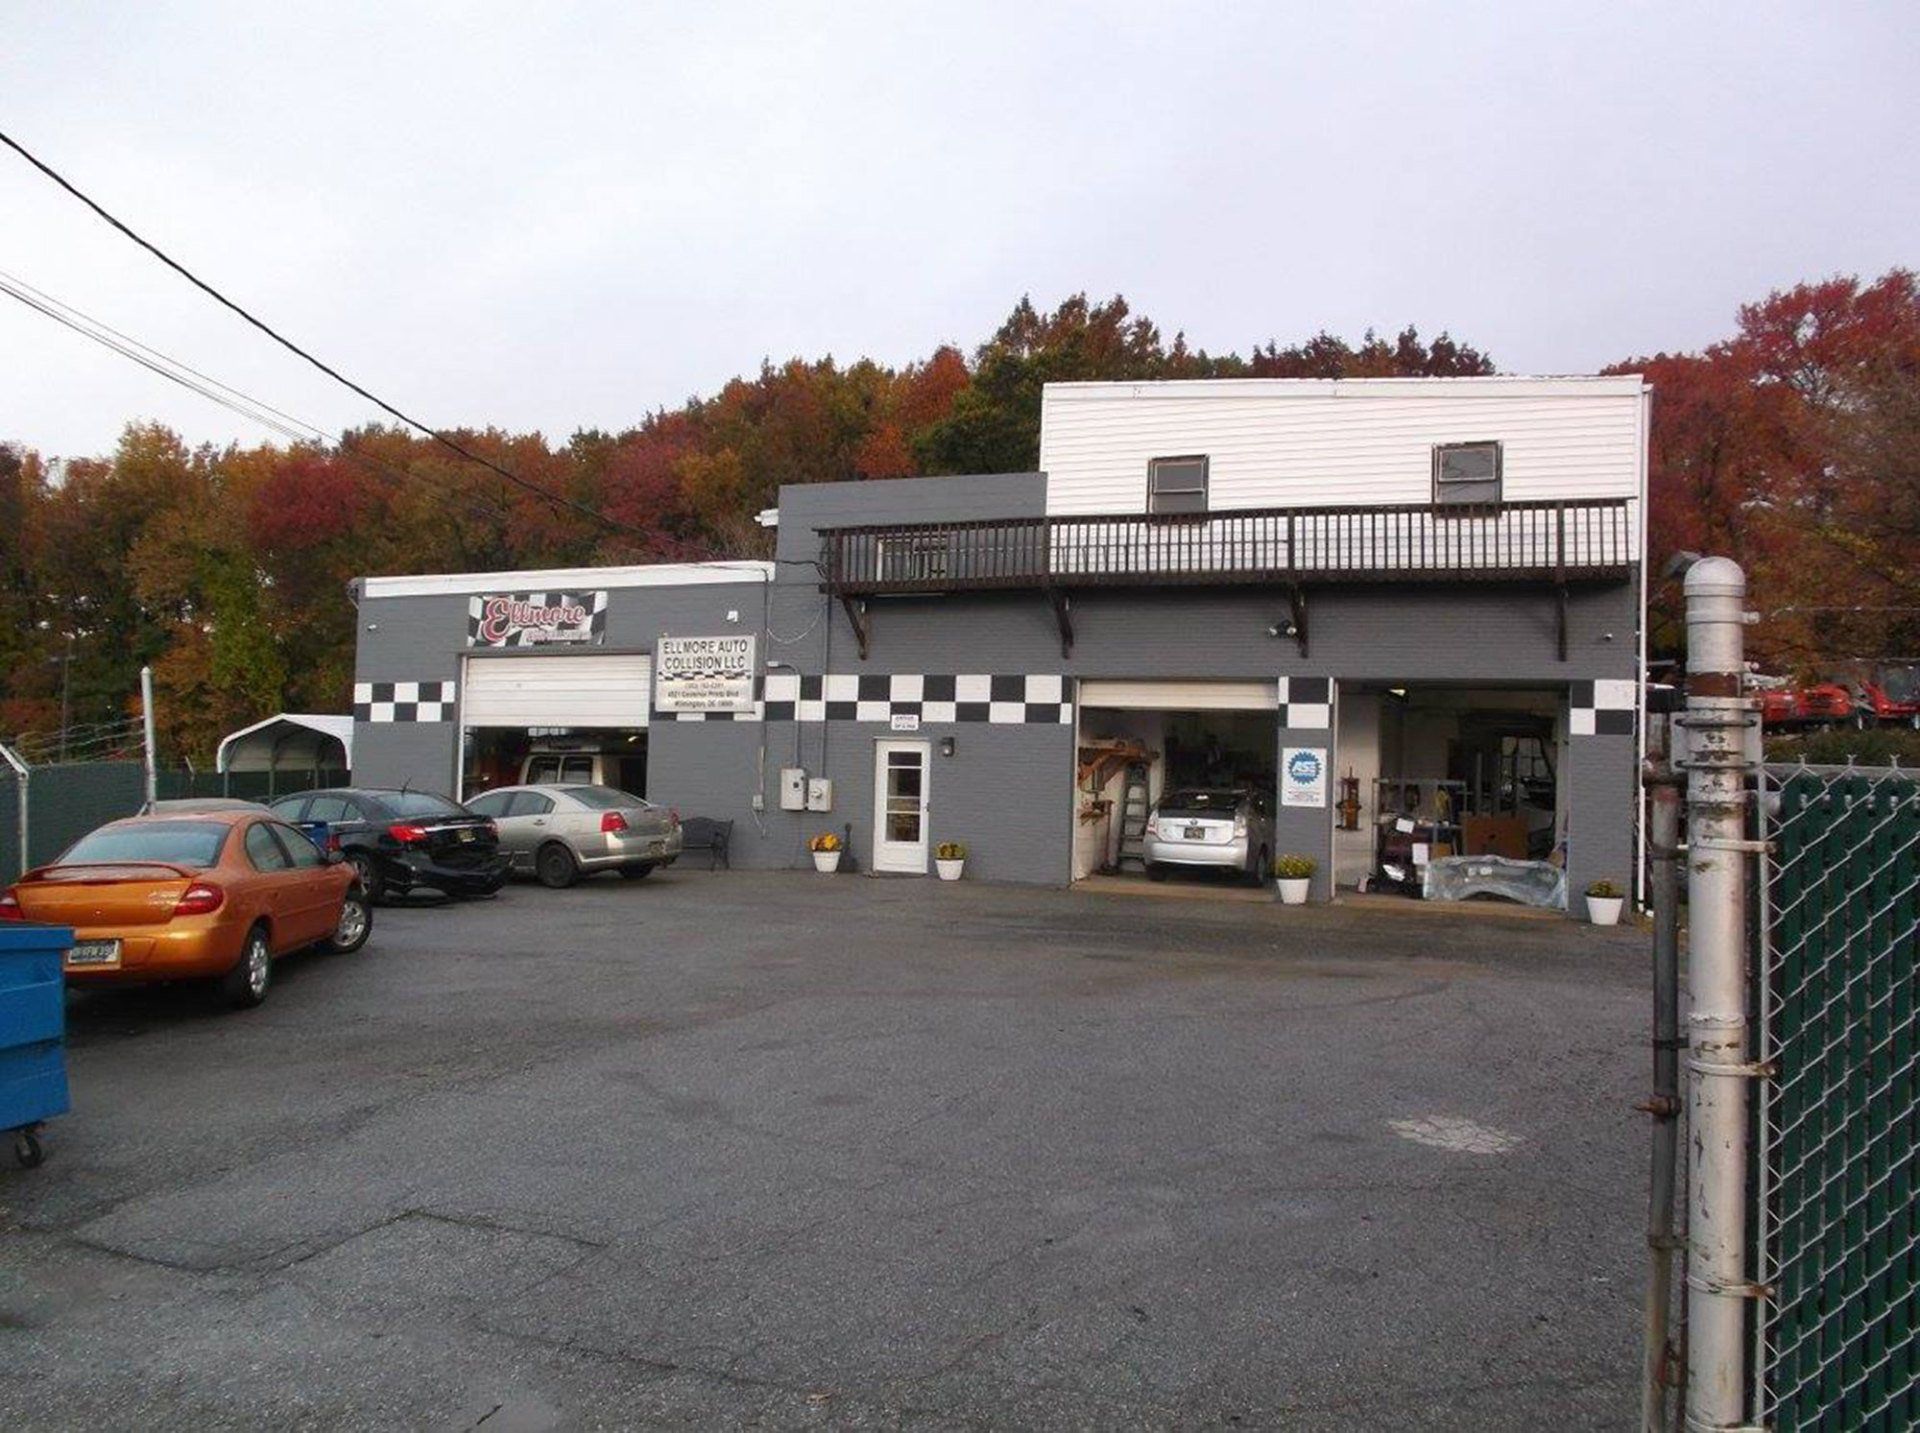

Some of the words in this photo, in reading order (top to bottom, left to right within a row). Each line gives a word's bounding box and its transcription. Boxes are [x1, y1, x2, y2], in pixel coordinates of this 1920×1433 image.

[481, 597, 586, 643] Ellmore
[663, 641, 715, 654] ELLMORE
[718, 639, 748, 653] AUTO
[665, 656, 721, 669] COLLISION
[724, 655, 745, 669] LLC
